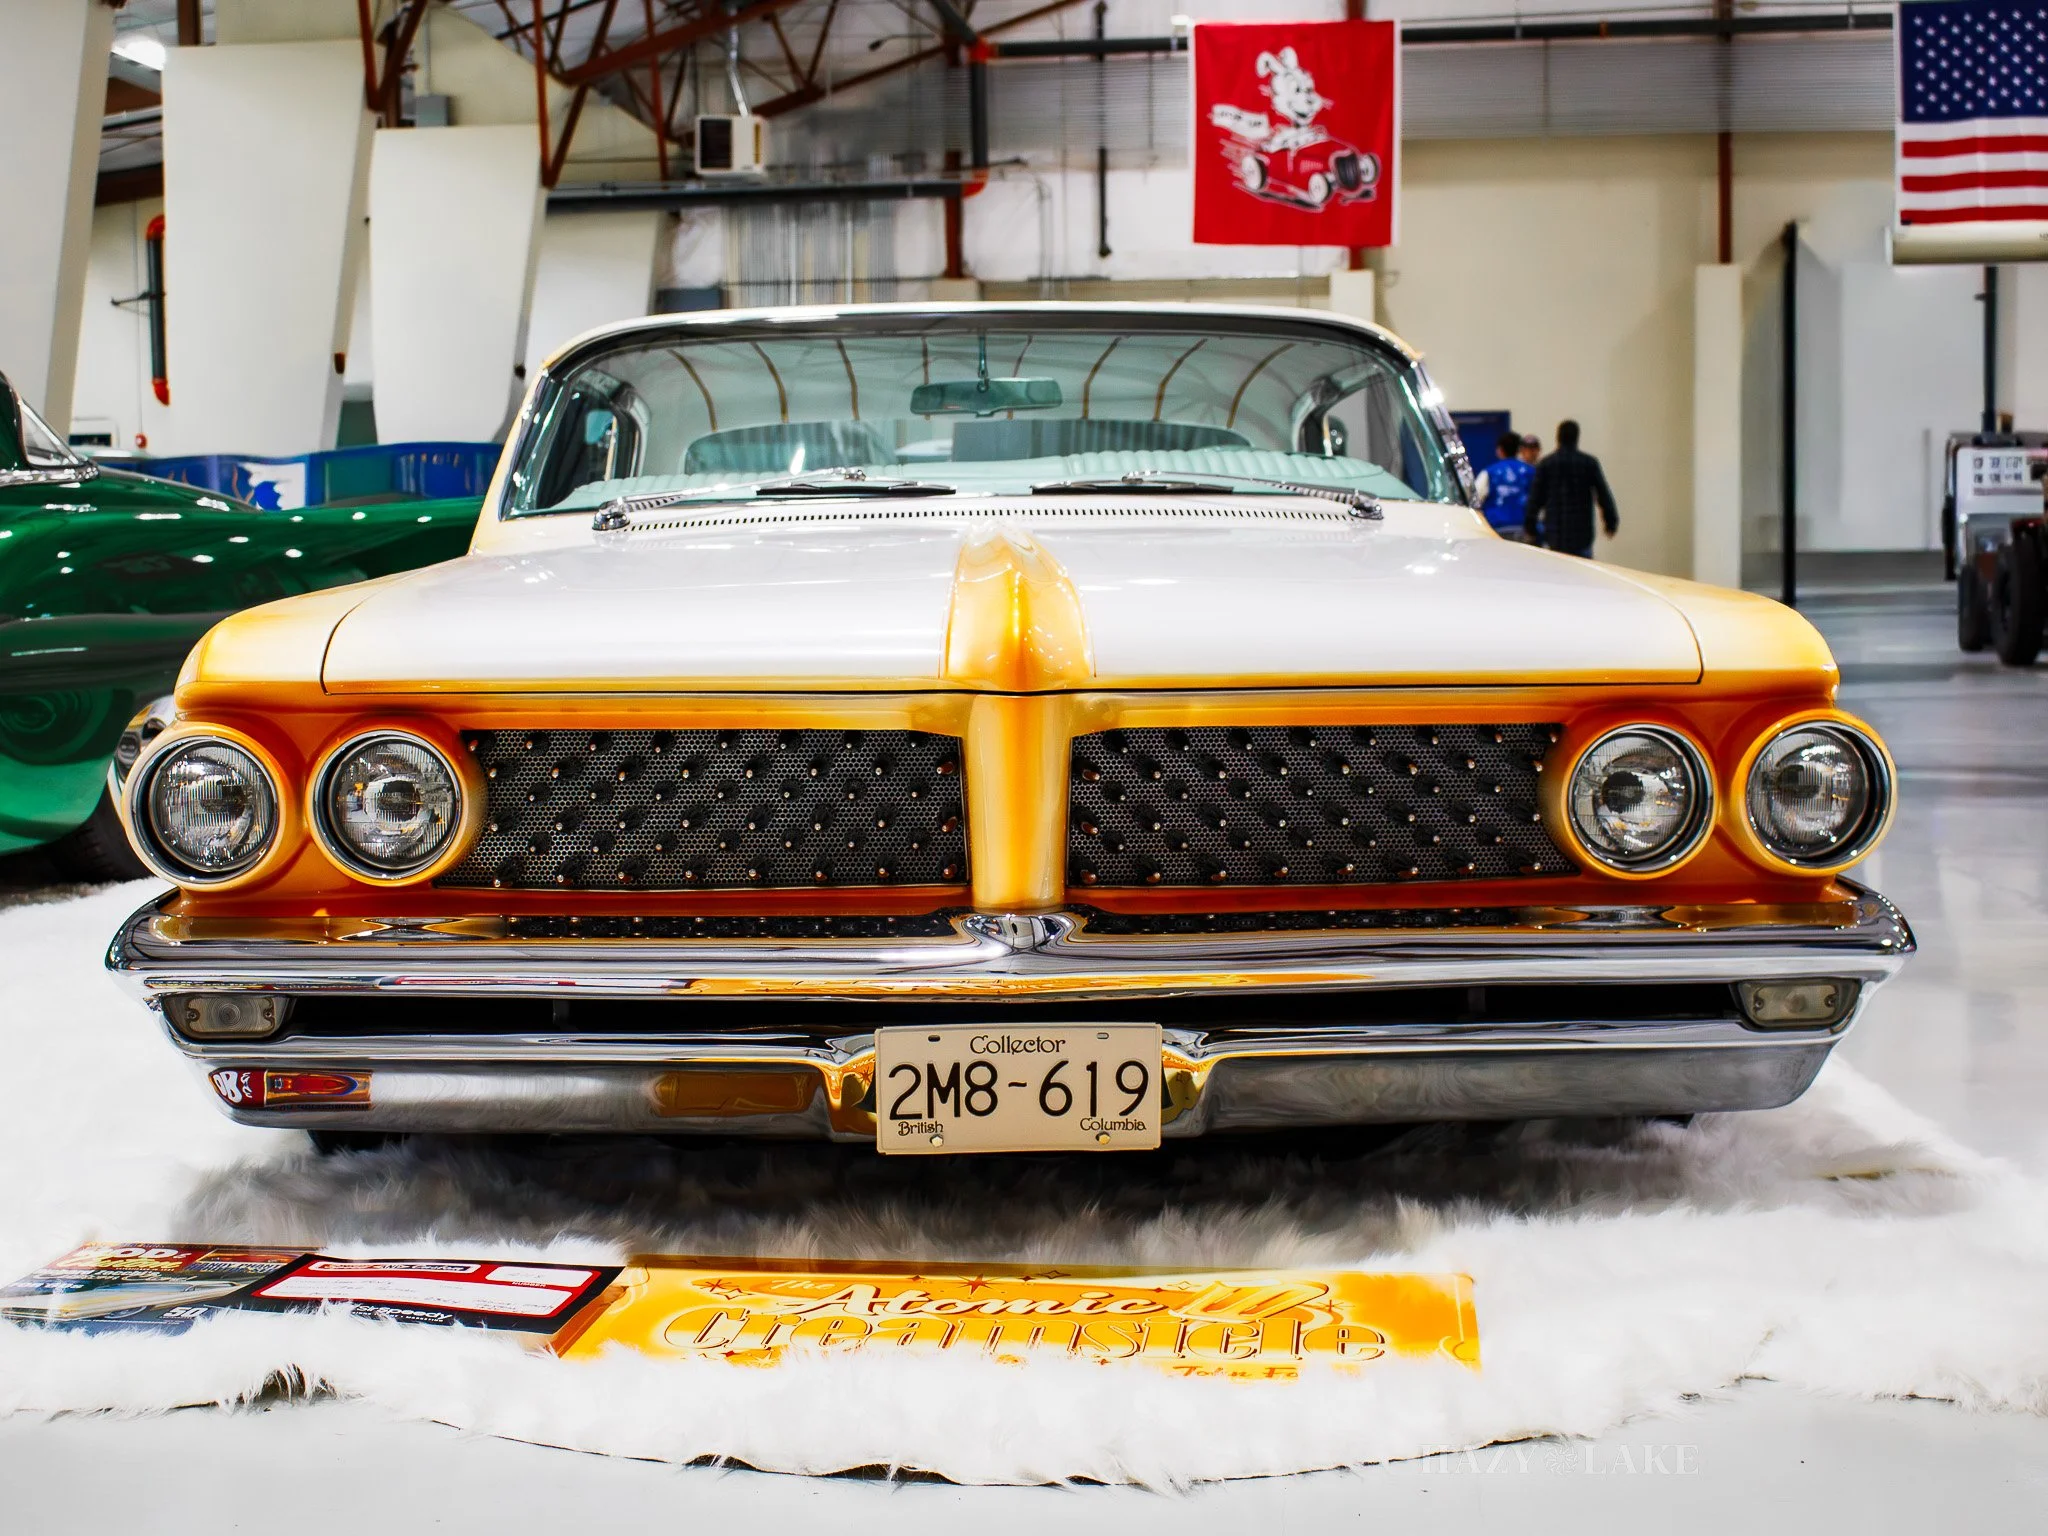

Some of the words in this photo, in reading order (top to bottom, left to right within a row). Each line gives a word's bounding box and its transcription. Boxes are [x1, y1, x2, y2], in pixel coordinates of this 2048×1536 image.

[969, 1035, 1066, 1055] Collector
[888, 1060, 1149, 1120] 2M8-619
[897, 1121, 944, 1136] British
[1079, 1117, 1147, 1132] Columbia
[770, 1279, 836, 1291] The
[762, 1283, 1168, 1316] Atomic
[664, 1307, 1386, 1361] Creamsicle
